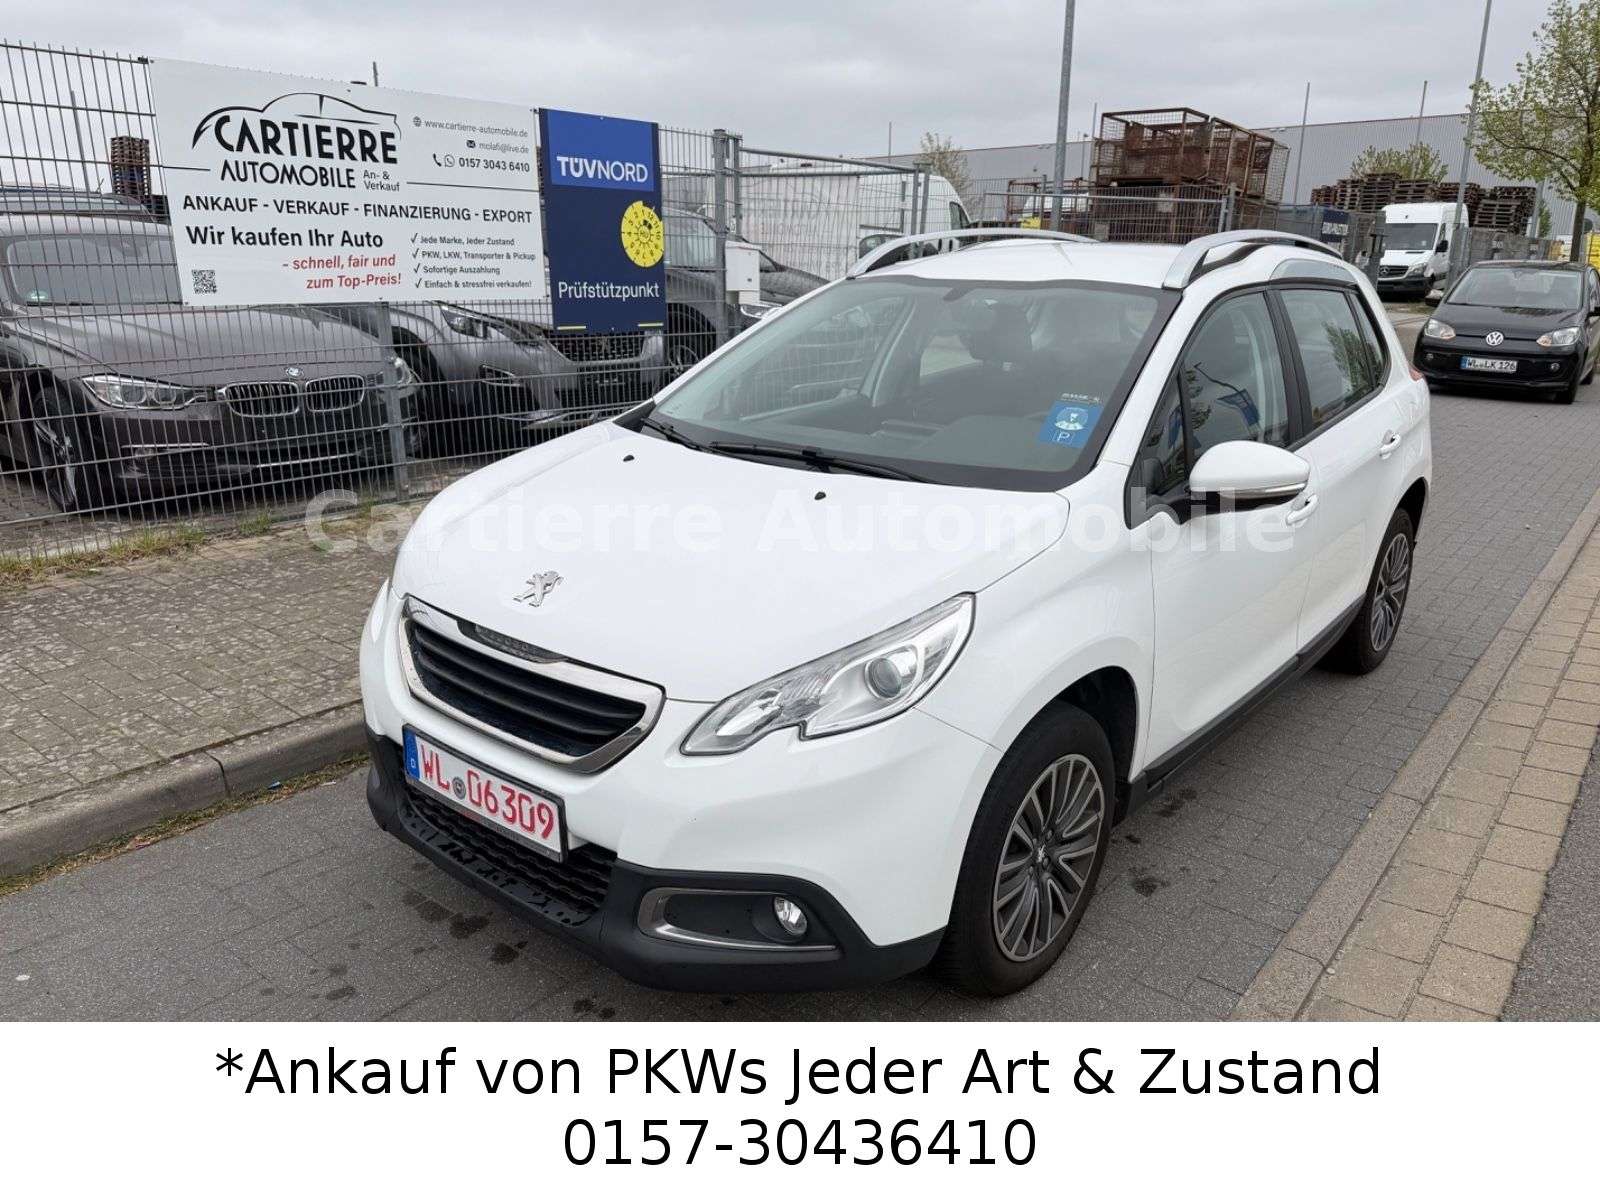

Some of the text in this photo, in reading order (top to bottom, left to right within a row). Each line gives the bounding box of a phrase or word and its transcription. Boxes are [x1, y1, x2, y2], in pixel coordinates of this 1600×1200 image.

[425, 120, 528, 138] www.cartierre-automobile.de
[214, 115, 397, 164] CARTIERRE
[458, 157, 530, 172] 0157 3043 6410
[221, 159, 356, 189] AUTOMOBILE
[363, 171, 390, 180] An- &
[364, 181, 400, 192] Verkauf
[183, 195, 258, 213] ANKAUF
[273, 200, 350, 216] VERKAUF
[364, 204, 471, 221] FINANZIERUNG
[483, 209, 532, 223] EXPORT
[186, 226, 383, 248] Wir kaufen Ihr Auto
[420, 236, 439, 244] Jede
[440, 236, 464, 246] Marke,
[486, 237, 515, 246] Zustand
[292, 255, 344, 270] schnell,
[348, 255, 369, 269] fair
[372, 254, 396, 268] und
[422, 250, 442, 260] PKW,
[443, 251, 462, 260] LKW,
[464, 251, 504, 261] Transporter
[513, 252, 536, 261] Pickup
[423, 265, 501, 275] Sofortige Auszahlung
[306, 273, 401, 290] zum Top-Preis!
[424, 279, 452, 288] Einfach
[462, 279, 495, 288] stressfrei
[496, 280, 532, 288] verkaufen!
[558, 280, 661, 302] Prüfstützpunkt
[421, 744, 450, 791] WL
